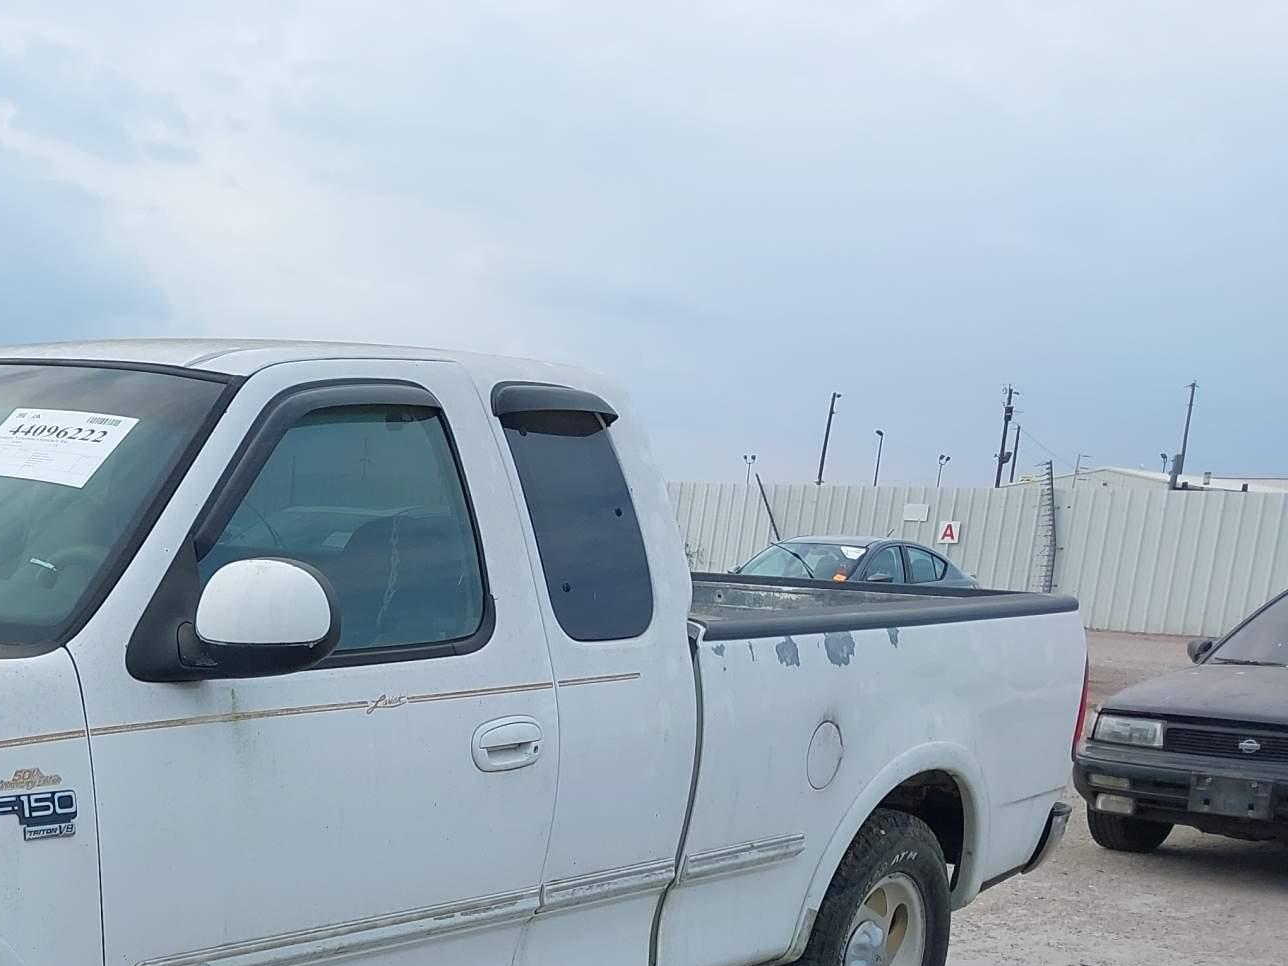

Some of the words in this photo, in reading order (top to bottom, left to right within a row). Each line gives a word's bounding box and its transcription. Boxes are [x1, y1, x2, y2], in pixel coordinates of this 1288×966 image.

[9, 423, 109, 443] 44096222
[941, 523, 955, 540] A
[57, 823, 74, 835] V8
